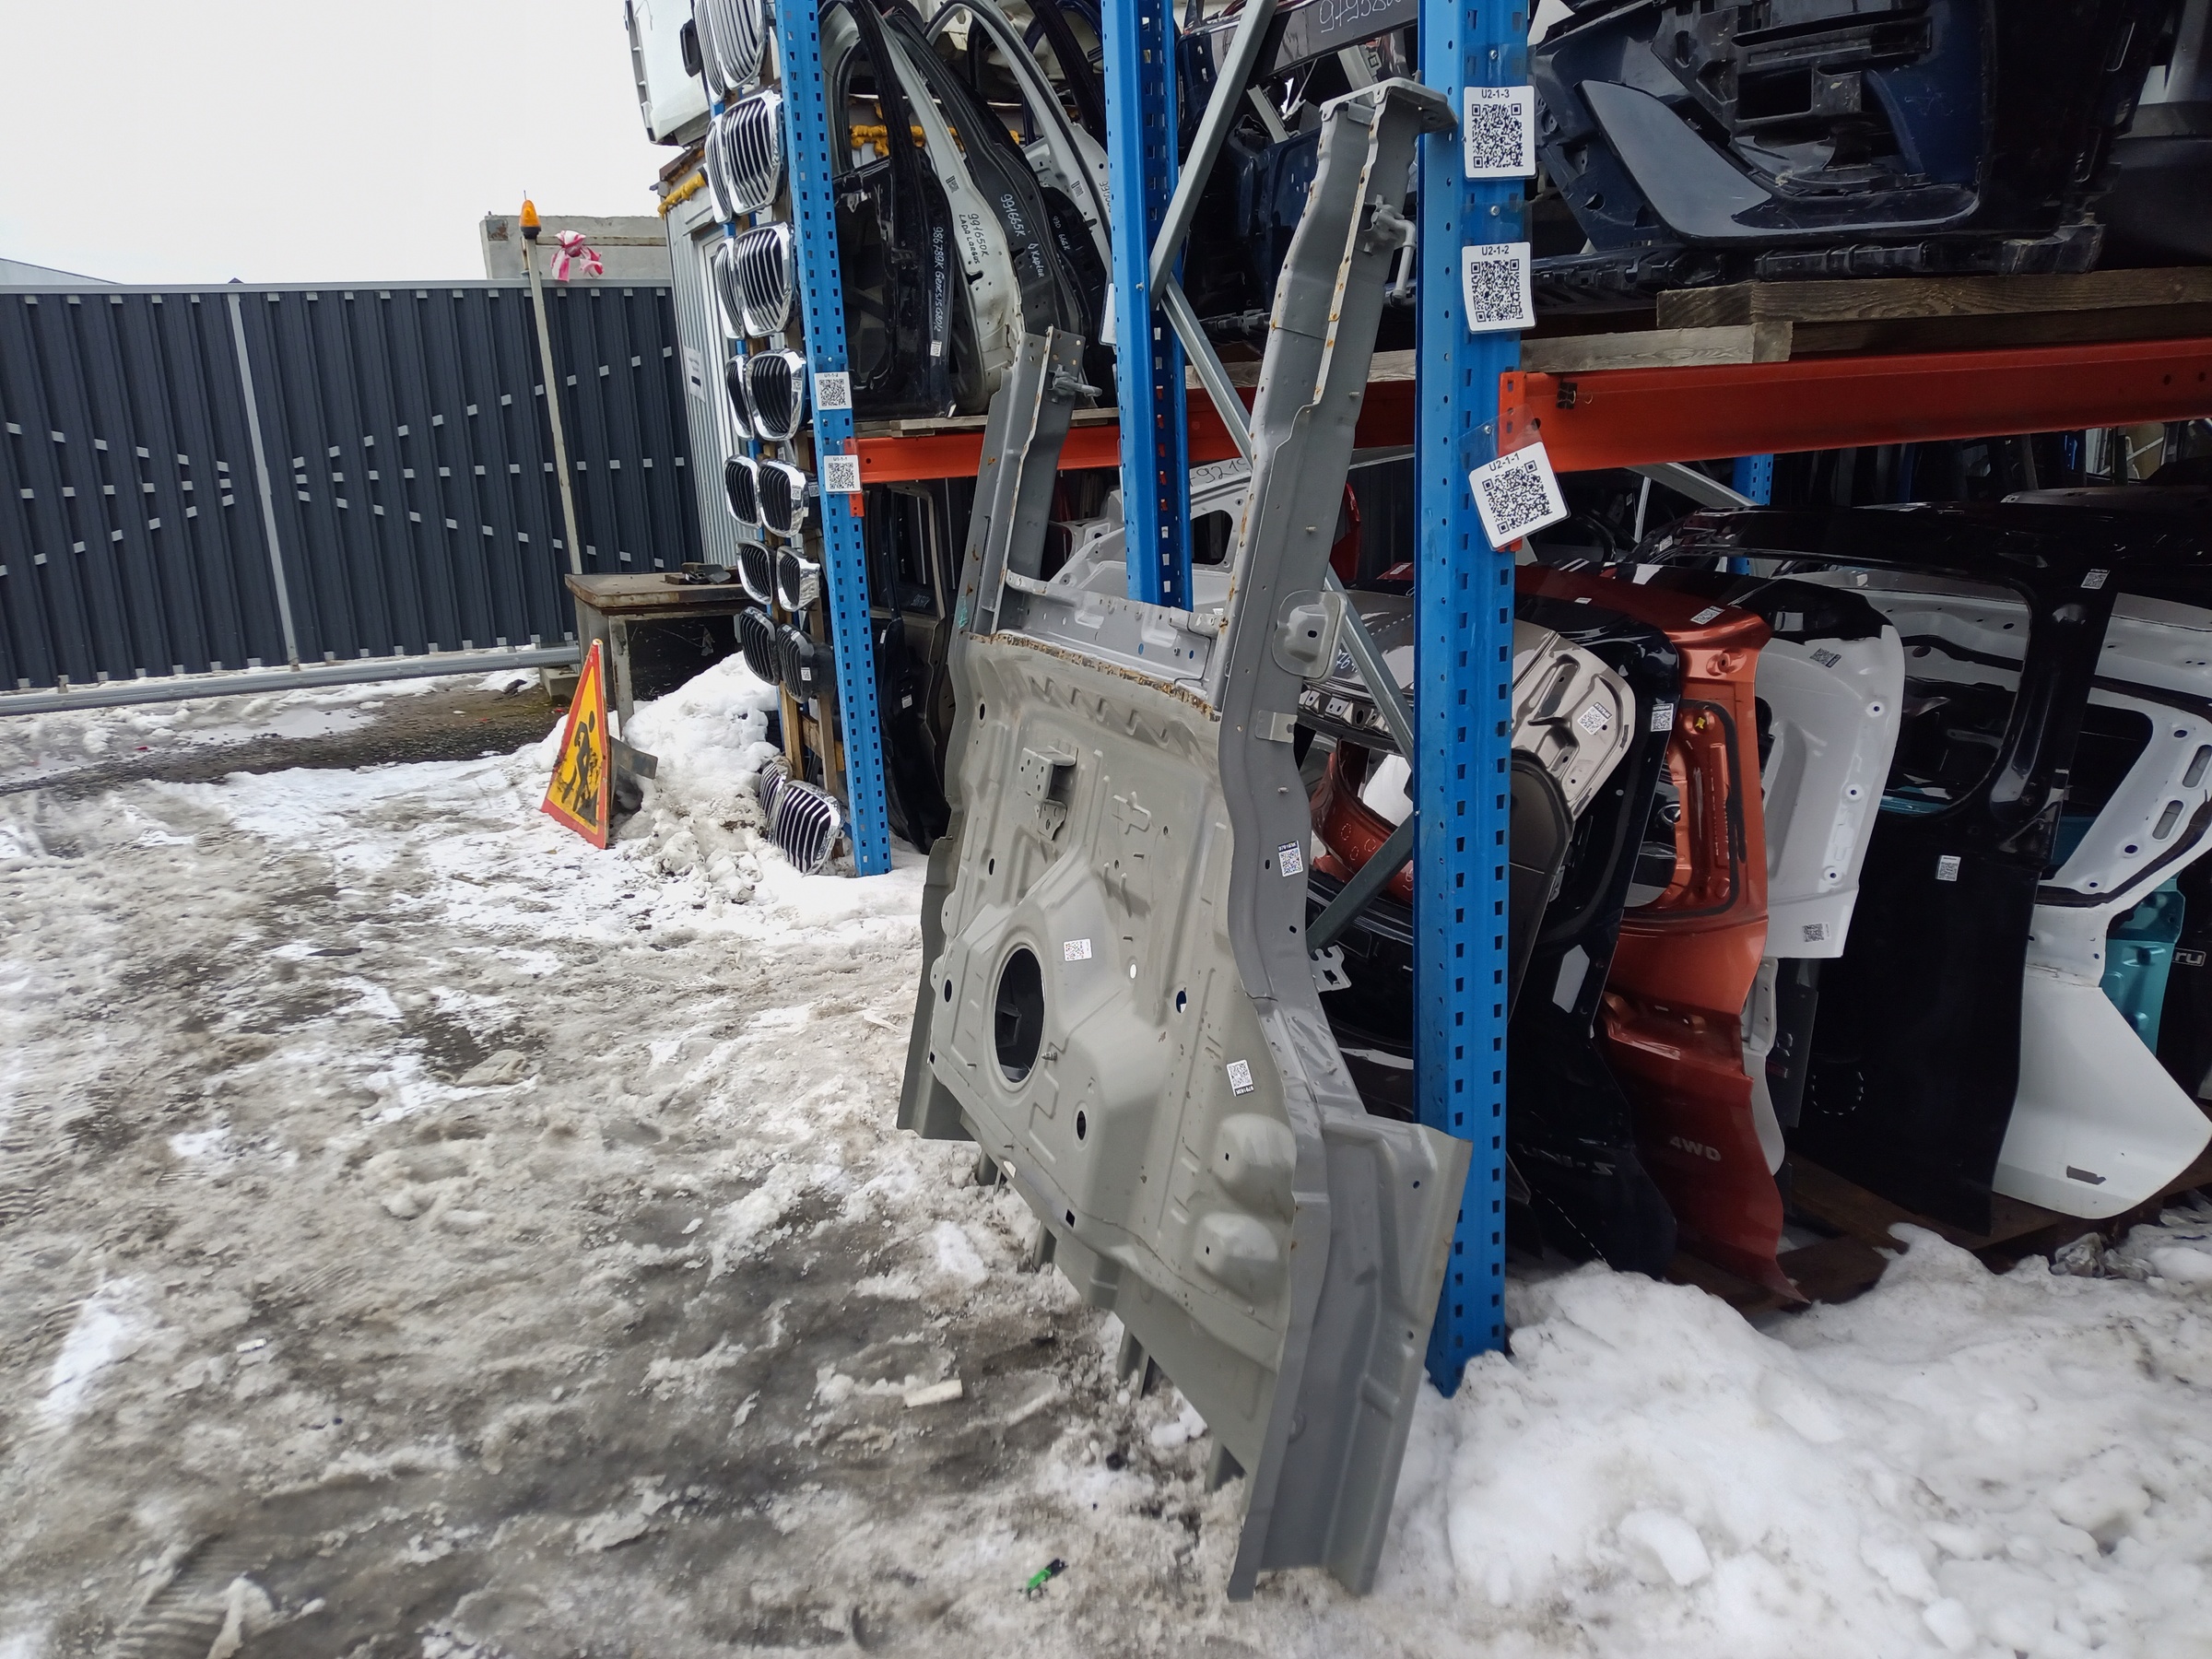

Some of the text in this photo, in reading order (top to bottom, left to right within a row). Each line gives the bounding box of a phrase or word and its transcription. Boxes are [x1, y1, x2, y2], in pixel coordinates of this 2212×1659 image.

[1481, 88, 1510, 99] U2-1-3
[1001, 194, 1026, 237] 991665K
[933, 227, 944, 269] 986789K
[968, 213, 989, 257] 991650K
[1481, 245, 1510, 255] U2-1-2
[1488, 453, 1520, 471] U2-1-1
[1669, 1135, 1722, 1161] 4WD
